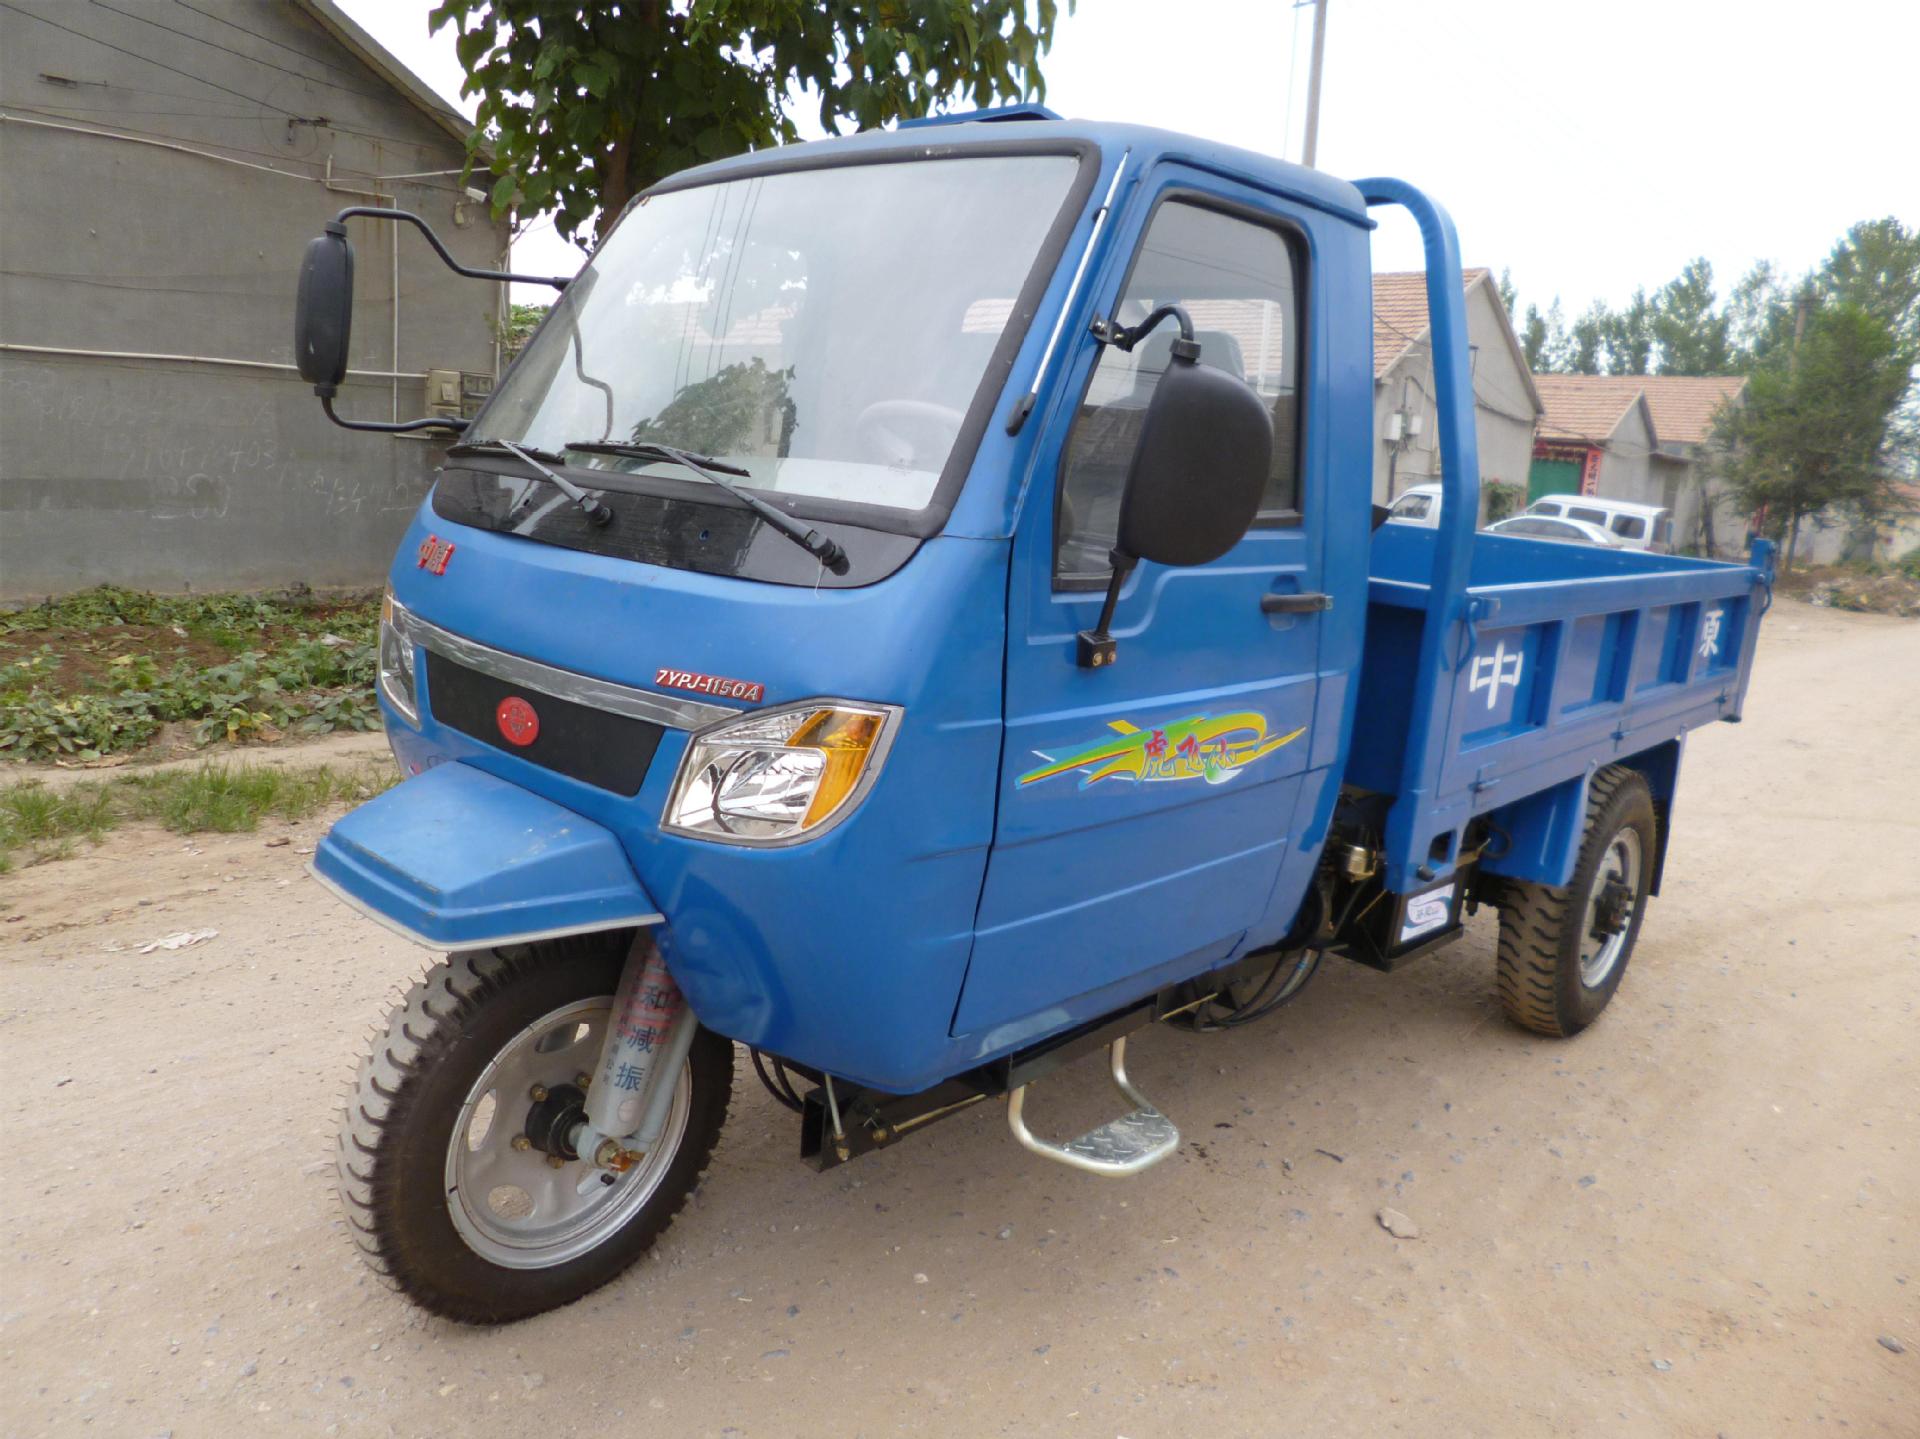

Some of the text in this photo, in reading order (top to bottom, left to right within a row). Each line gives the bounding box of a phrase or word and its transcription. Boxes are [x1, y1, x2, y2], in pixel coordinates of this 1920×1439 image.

[656, 669, 759, 701] 7YPJ-1150A
[1469, 641, 1523, 710] 中
[613, 960, 670, 1092] 和减振
